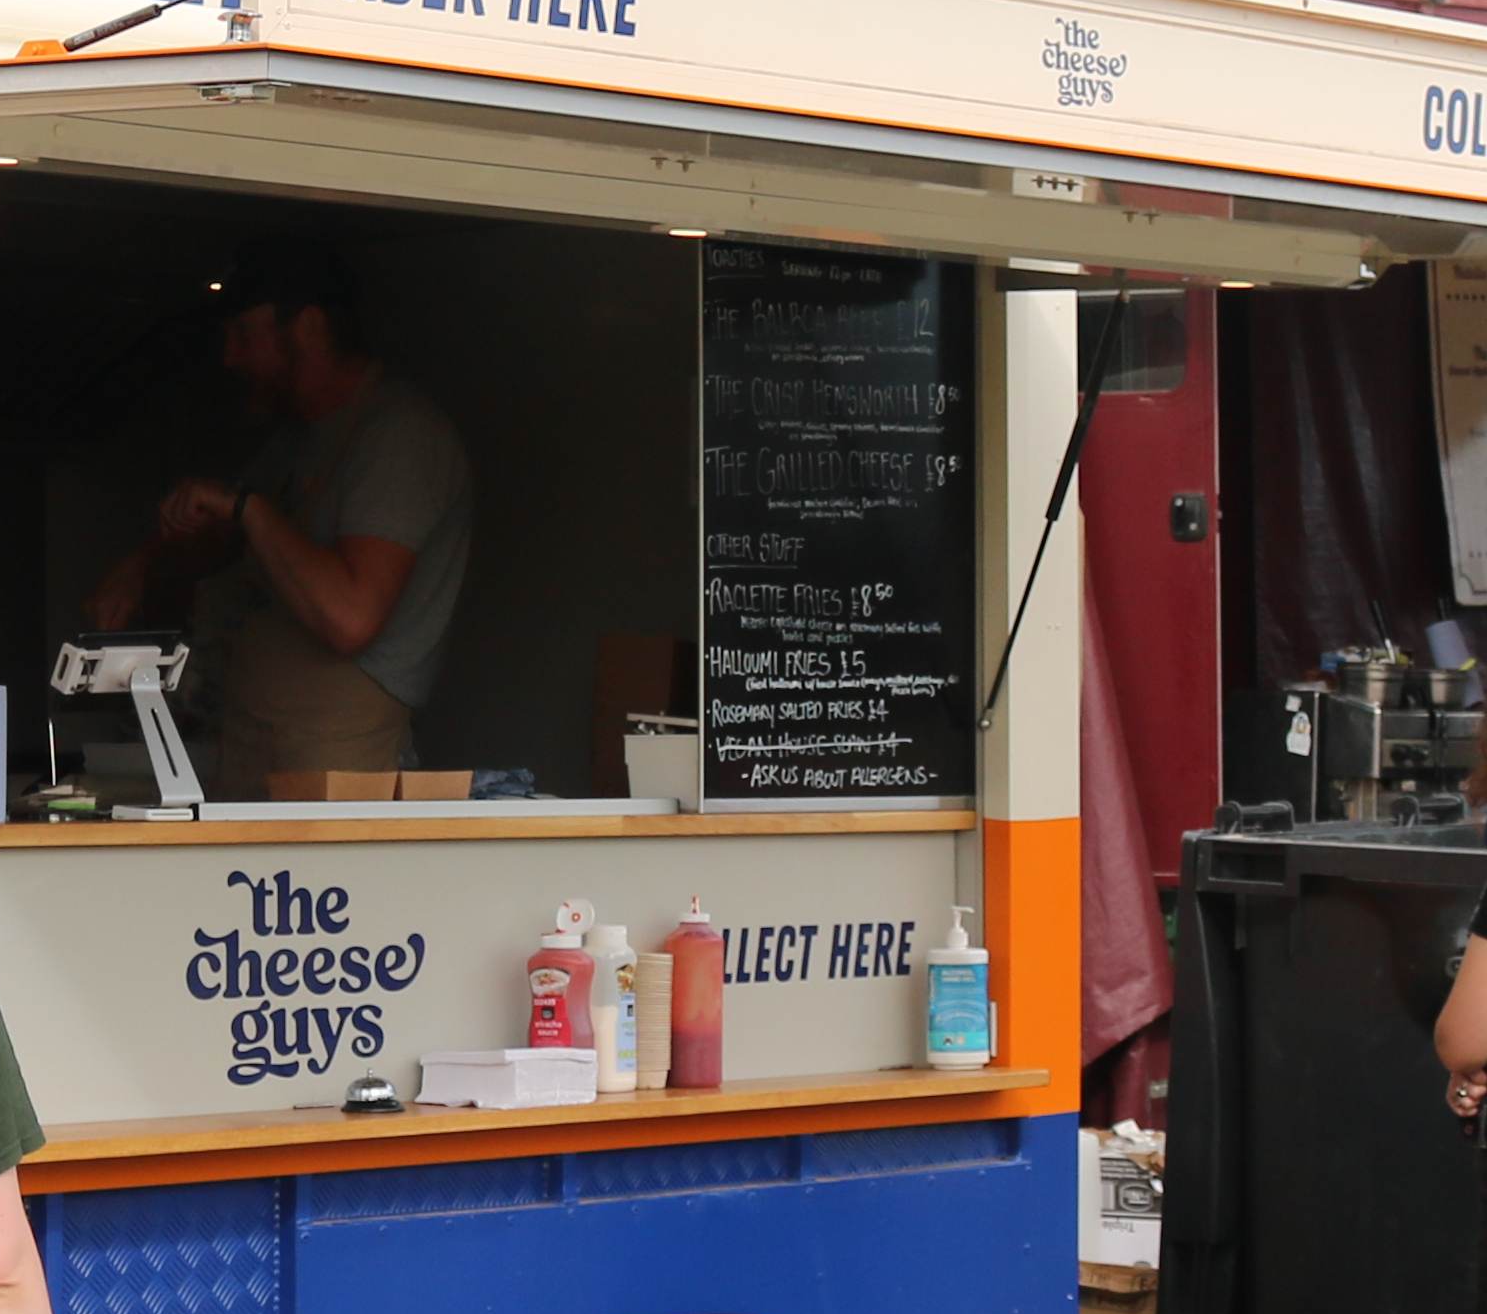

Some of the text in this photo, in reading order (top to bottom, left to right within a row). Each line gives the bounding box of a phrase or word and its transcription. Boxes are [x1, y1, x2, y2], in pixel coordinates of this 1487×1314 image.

[1054, 17, 1100, 50] the
[1041, 38, 1128, 77] cheese
[1057, 72, 1114, 107] guys
[750, 376, 805, 417] CRISP
[812, 378, 919, 418] HEMSWORTH
[755, 446, 844, 495] GRILLED
[848, 448, 915, 493] CHEESE
[706, 532, 806, 563] OTHER STUFF
[709, 576, 789, 617] RACLETTE
[793, 583, 844, 617] FRIES
[709, 646, 867, 679] HALLOUMI FRIES £5
[711, 698, 890, 728] ROSEMARY SALTED FRIES £4
[781, 765, 799, 785] US
[803, 767, 848, 789] ABOUT
[227, 869, 350, 937] the
[185, 926, 426, 1001] cheese
[723, 920, 916, 985] LLECT HERE
[226, 998, 385, 1085] guys
